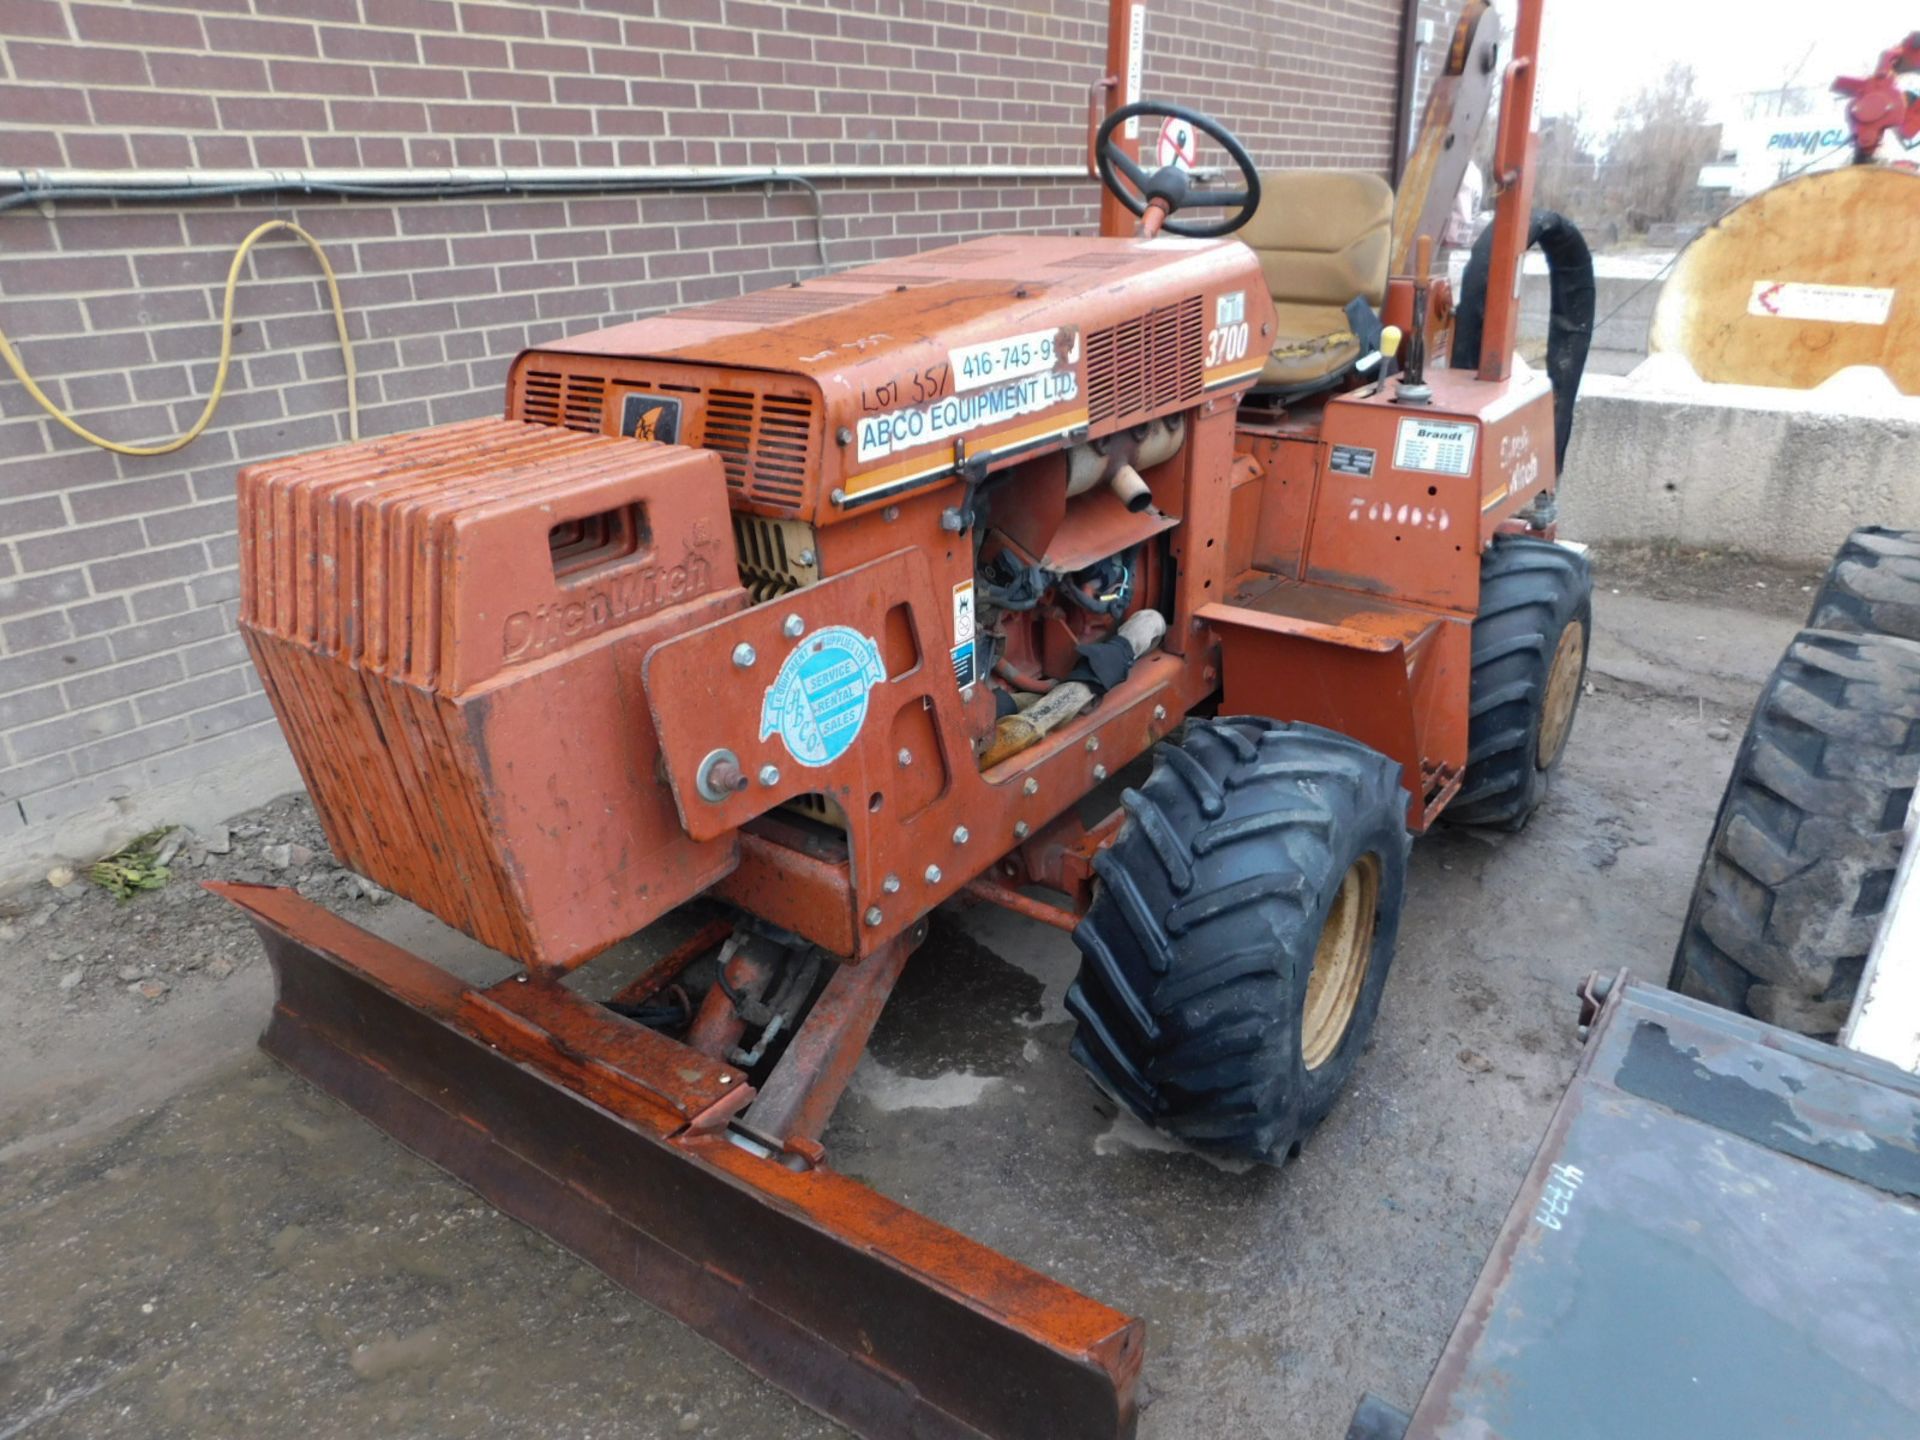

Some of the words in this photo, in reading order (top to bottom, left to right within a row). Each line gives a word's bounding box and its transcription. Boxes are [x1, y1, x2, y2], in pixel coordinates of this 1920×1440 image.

[1767, 129, 1849, 155] PINNACL
[1205, 322, 1248, 367] 3700
[862, 411, 924, 451] ABCO
[931, 380, 1038, 431] EQUIPMENT
[1417, 428, 1463, 441] Brandt
[810, 662, 850, 689] SERVICE
[816, 686, 855, 712] RENTAL
[823, 710, 855, 735] SALES
